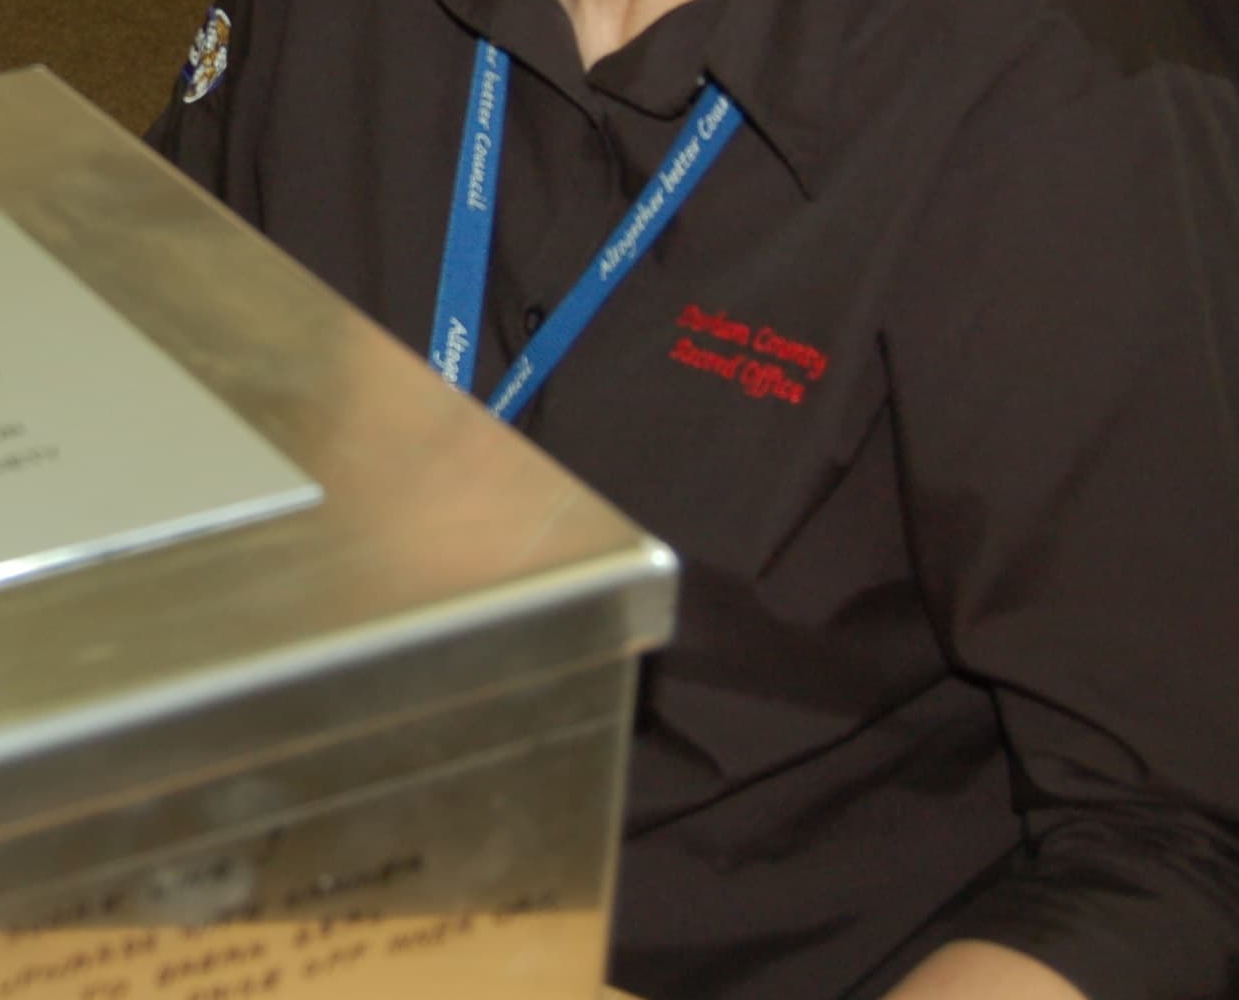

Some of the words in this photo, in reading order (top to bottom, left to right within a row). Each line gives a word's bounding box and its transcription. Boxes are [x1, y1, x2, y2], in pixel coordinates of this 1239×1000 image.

[478, 72, 499, 132] better
[467, 134, 491, 211] Council
[660, 138, 701, 193] better
[754, 328, 828, 380] County
[740, 360, 806, 405] Office
